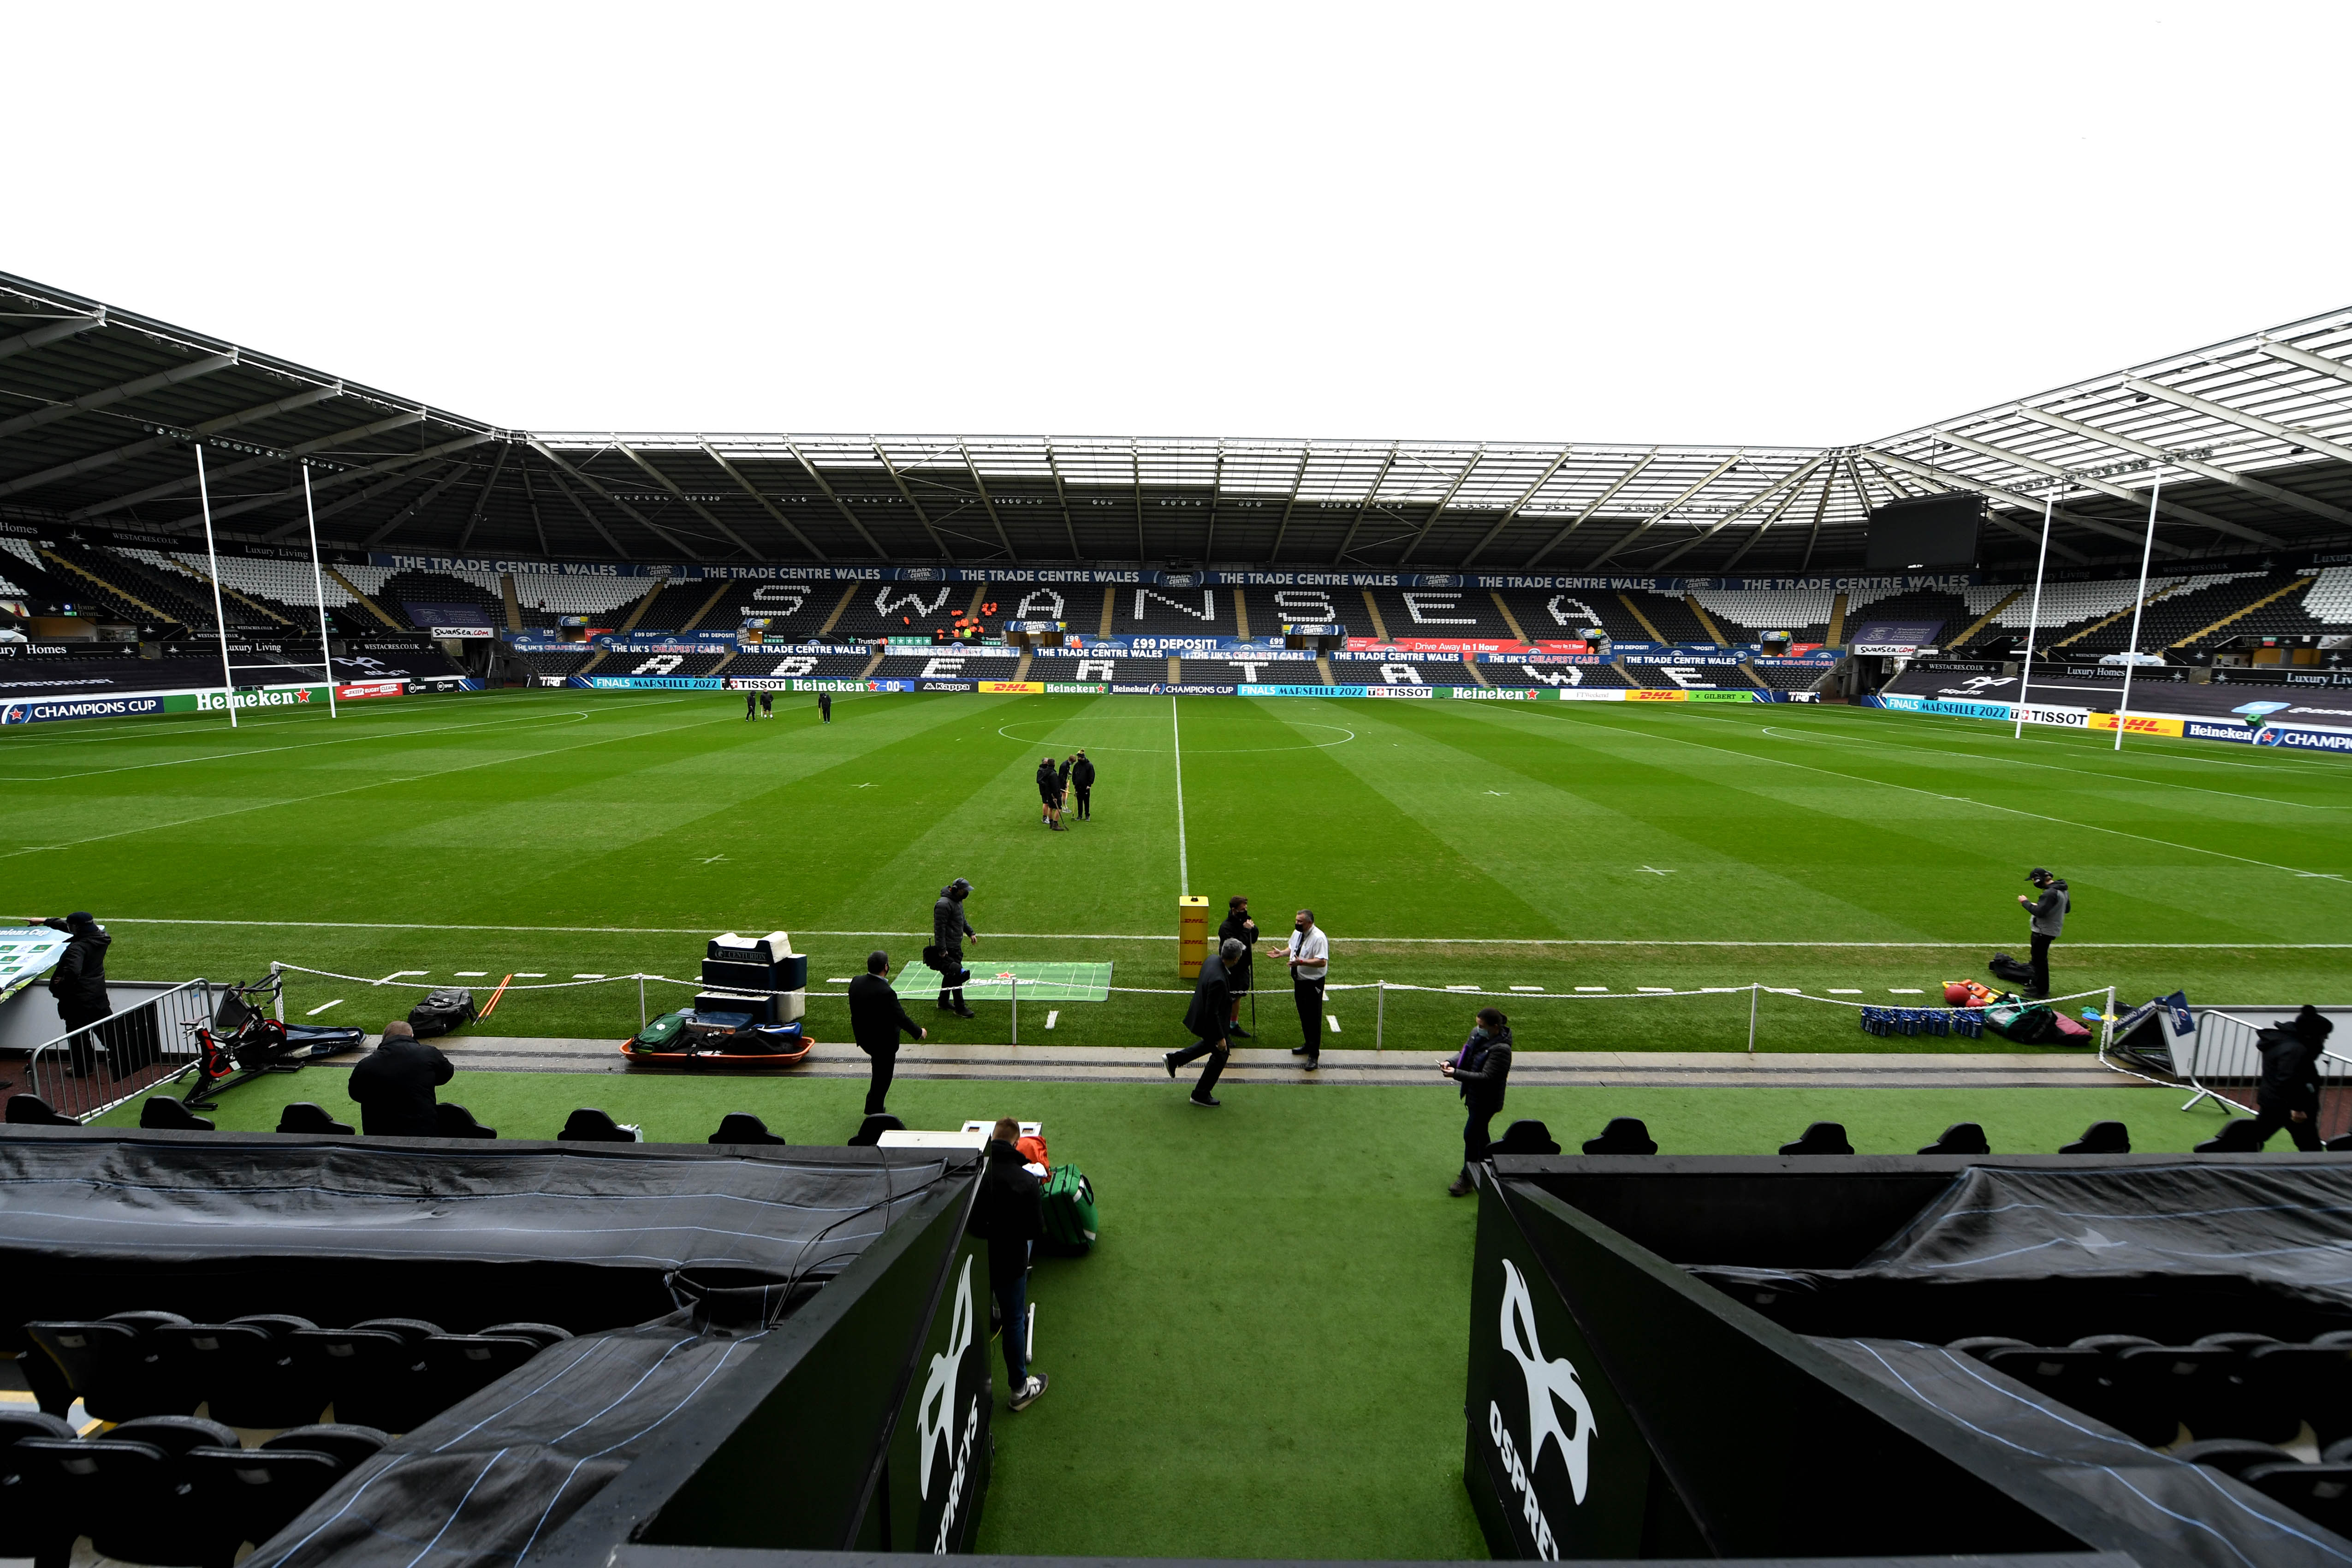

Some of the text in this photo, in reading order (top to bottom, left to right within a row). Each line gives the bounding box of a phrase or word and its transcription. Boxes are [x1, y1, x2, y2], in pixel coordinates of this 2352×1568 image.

[0, 522, 38, 535] Homes
[112, 532, 179, 545] WESTACRES.CO.UK
[245, 545, 309, 559] Luxury Living
[392, 555, 618, 576] THE TRADE CENTRE WALES
[702, 567, 881, 580] THE TRADE CENTRE WALES
[960, 570, 1140, 582] THE TRADE CENTRE WALES
[1219, 572, 1398, 586] THE TRADE CENTRE WALES
[2022, 572, 2055, 582] Luury
[1478, 576, 1656, 590] THE TRADE CENTRE WALES
[1742, 575, 1970, 590] THE TRADE CENTRE WALES
[26, 644, 67, 654] Homes
[256, 643, 281, 653] Living
[1133, 638, 1217, 649] £99 DEPOSIT!
[1440, 643, 1461, 652] Away
[1057, 648, 1089, 657] TRADE
[1092, 649, 1128, 657] CENTRE
[1130, 649, 1163, 658] WALES
[1354, 652, 1385, 660] TRADE
[1388, 653, 1425, 661] CENTRE
[1426, 653, 1459, 661] WALES
[1575, 656, 1599, 664] CARS
[2067, 666, 2126, 677] Luxury Homes
[596, 678, 717, 688] FINALS MARSEILLE 2022
[739, 680, 784, 689] TISSOT
[793, 679, 865, 691] Heineken
[2286, 673, 2330, 686] Luxury
[993, 683, 1030, 692] DHL
[1046, 683, 1096, 693] Heineken
[1241, 686, 1363, 695] FINALS MARSEILLE 2022
[1386, 688, 1431, 696] TISSOT
[1453, 687, 1524, 700] Heineken
[34, 700, 156, 718] CHAMPIONS CUP
[1889, 699, 2006, 718] FINALS MARSEILLE 2022
[2031, 710, 2088, 725] TISSOT
[2107, 717, 2160, 732] DHL
[2189, 724, 2352, 750] Heineken CHAMPI
[728, 951, 766, 960] CENTURION
